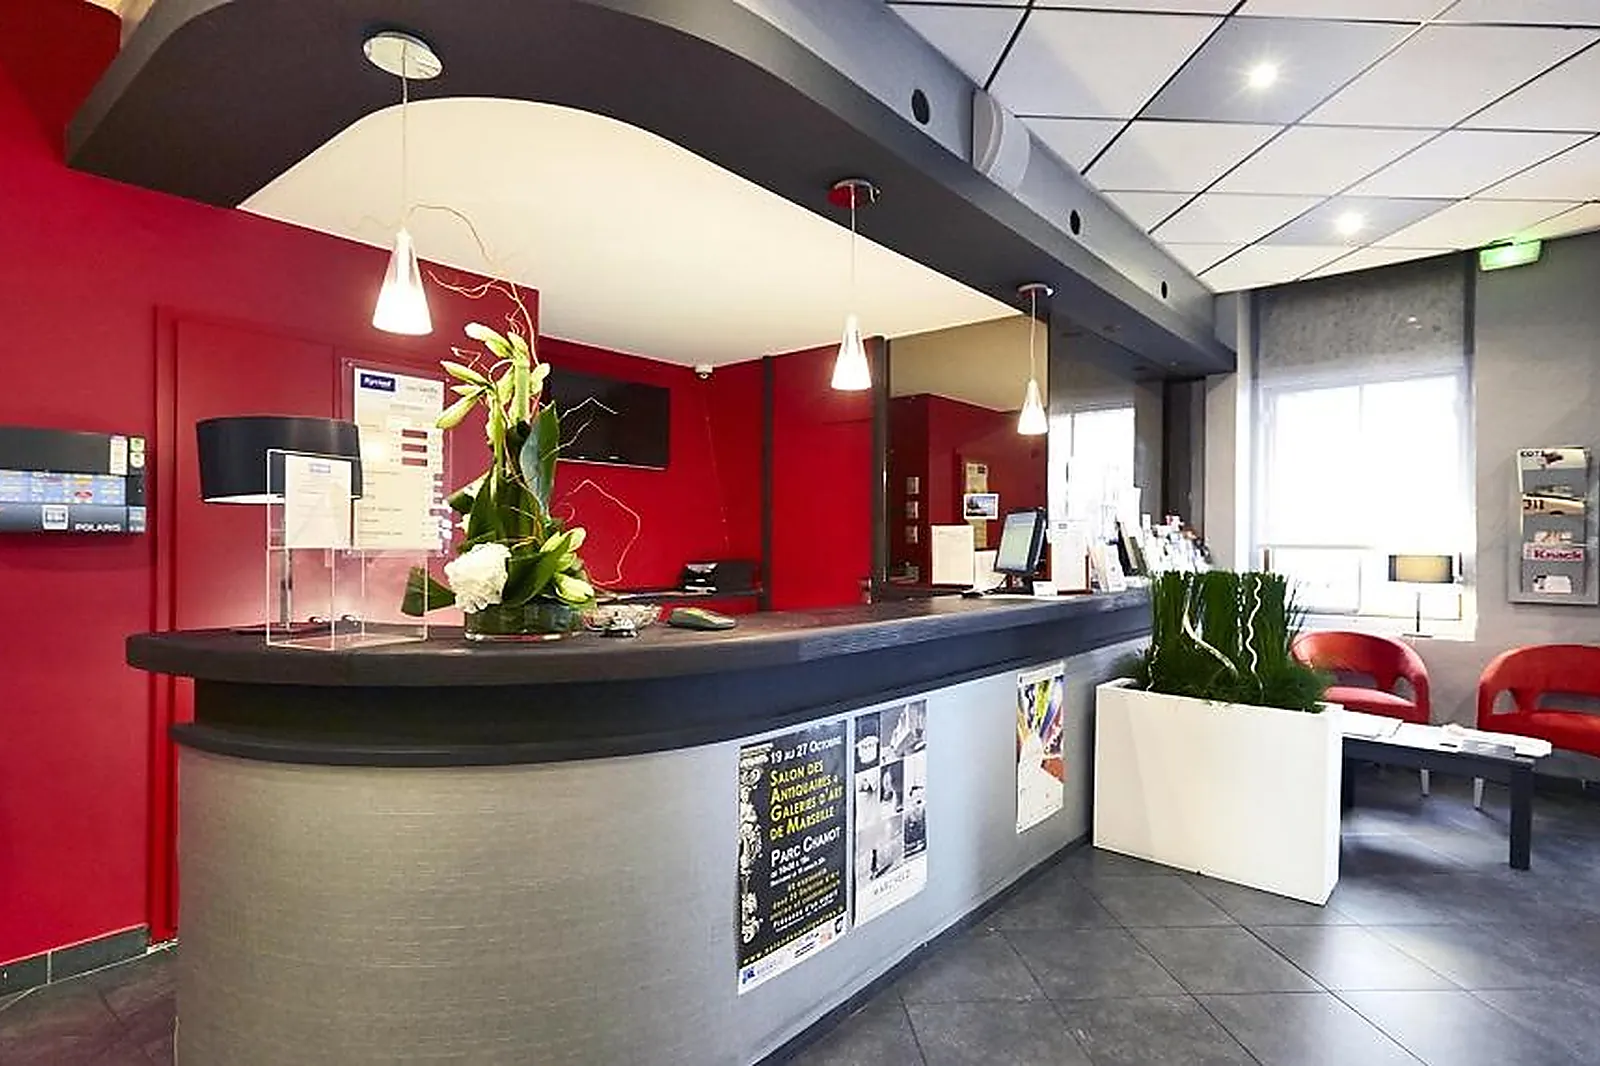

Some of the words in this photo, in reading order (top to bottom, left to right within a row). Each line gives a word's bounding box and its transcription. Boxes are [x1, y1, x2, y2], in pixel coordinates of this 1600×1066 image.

[75, 523, 121, 532] POLARIS
[771, 750, 783, 764] 19
[796, 742, 808, 758] 27
[770, 765, 805, 787] SALON
[769, 825, 785, 841] DE
[771, 845, 801, 868] PARC
